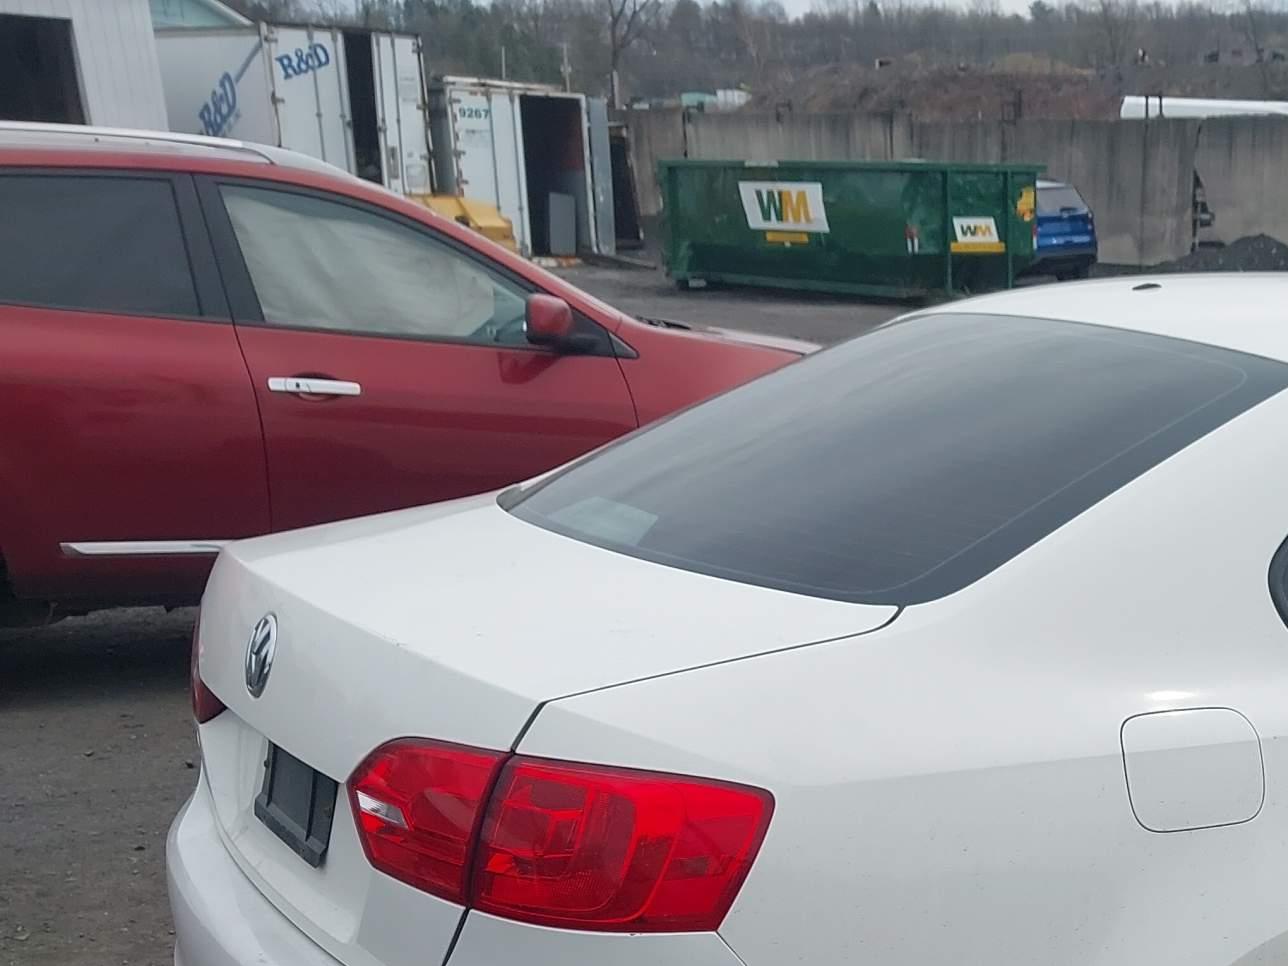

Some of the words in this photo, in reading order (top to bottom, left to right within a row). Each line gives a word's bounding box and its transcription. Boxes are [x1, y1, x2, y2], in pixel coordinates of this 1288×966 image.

[276, 43, 330, 80] R&D
[459, 106, 489, 119] 9267
[755, 189, 812, 224] WM
[960, 224, 993, 237] WM
